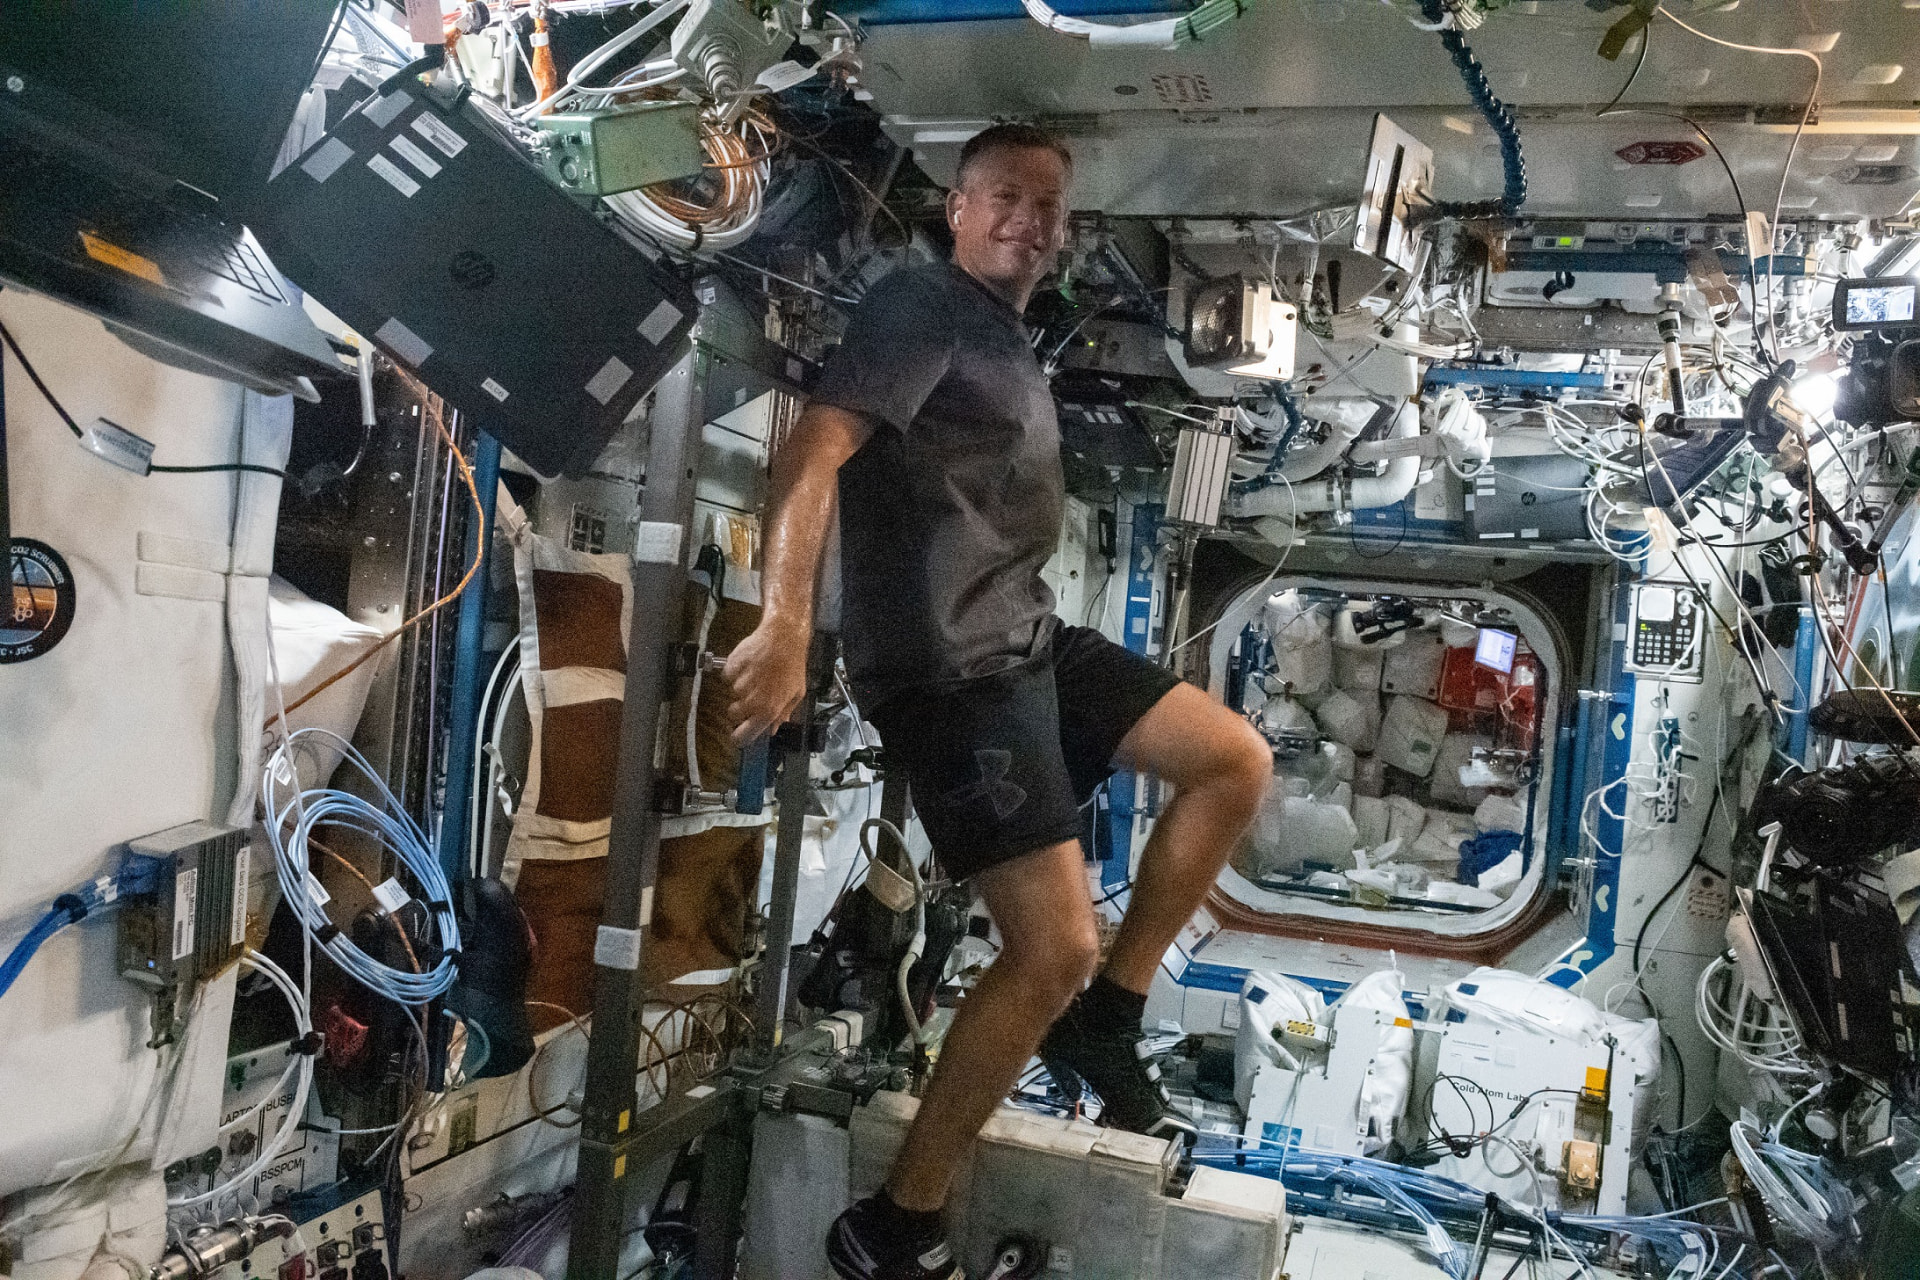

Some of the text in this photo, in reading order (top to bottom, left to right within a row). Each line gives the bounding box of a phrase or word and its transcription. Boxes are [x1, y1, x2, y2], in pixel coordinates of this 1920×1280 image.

[11, 545, 65, 585] CO2 SCRUBBER
[15, 644, 34, 656] JSC
[1452, 1081, 1475, 1093] Cold
[1507, 1092, 1526, 1102] Lab
[261, 1157, 302, 1183] BSSPCM
